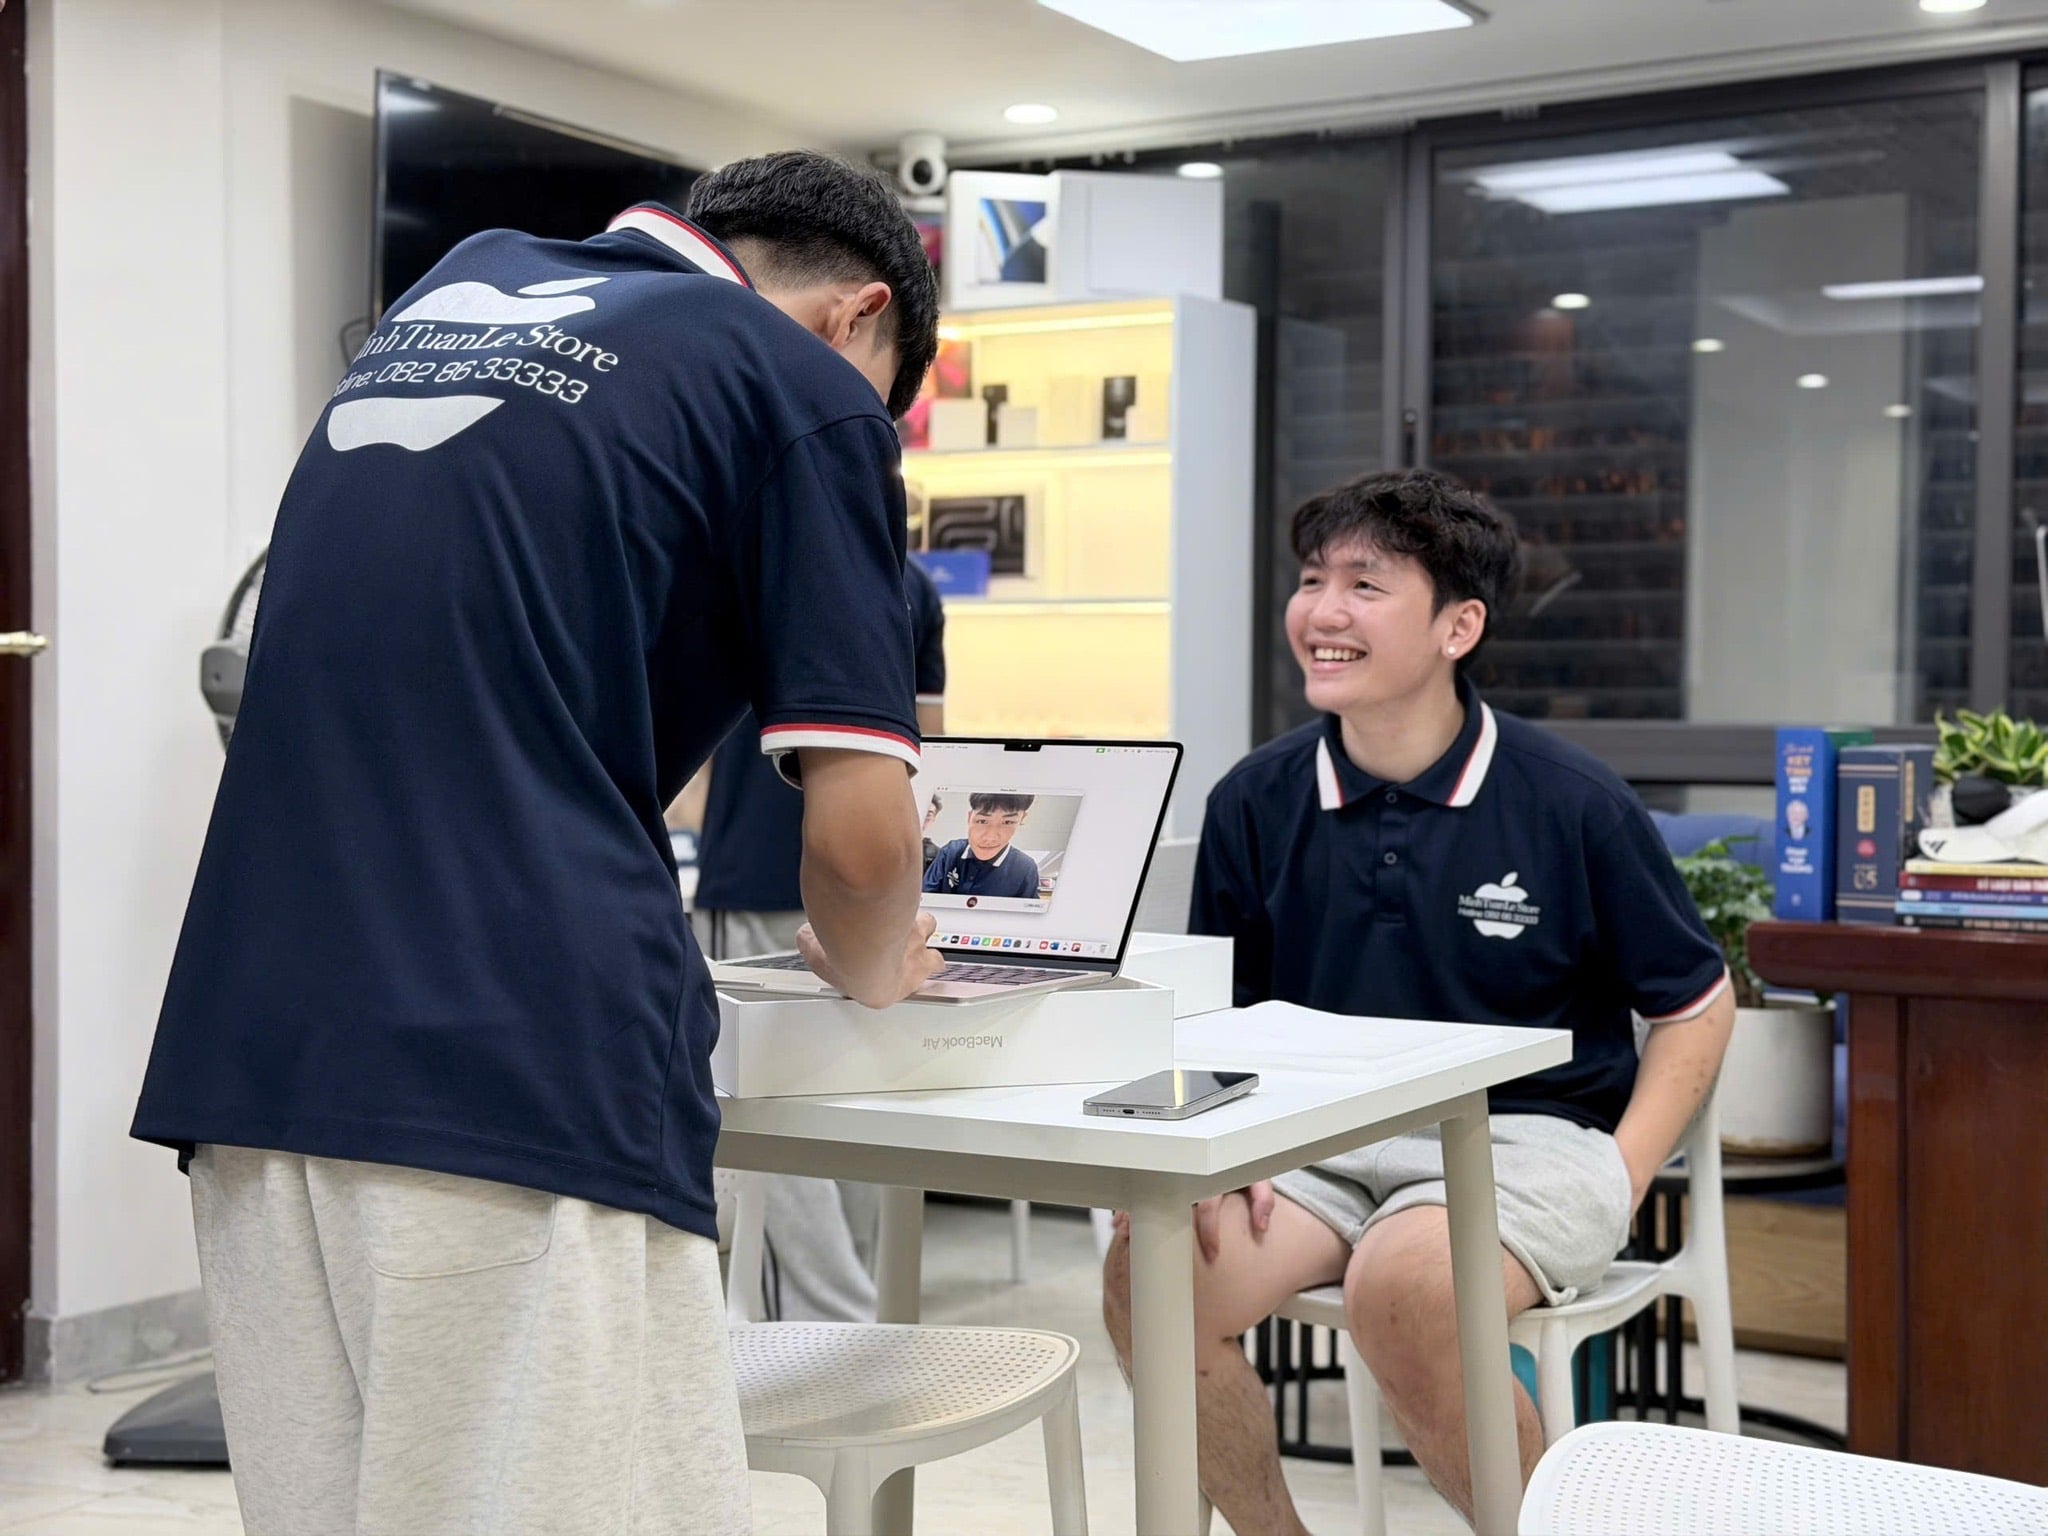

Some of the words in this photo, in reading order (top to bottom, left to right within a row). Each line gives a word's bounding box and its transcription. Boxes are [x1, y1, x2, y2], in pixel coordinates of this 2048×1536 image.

[515, 324, 619, 372] Store
[375, 361, 436, 383] 082
[434, 360, 478, 382] 86
[474, 357, 589, 404] 33333
[923, 1037, 940, 1050] Air
[942, 1035, 1003, 1050] MacBook
